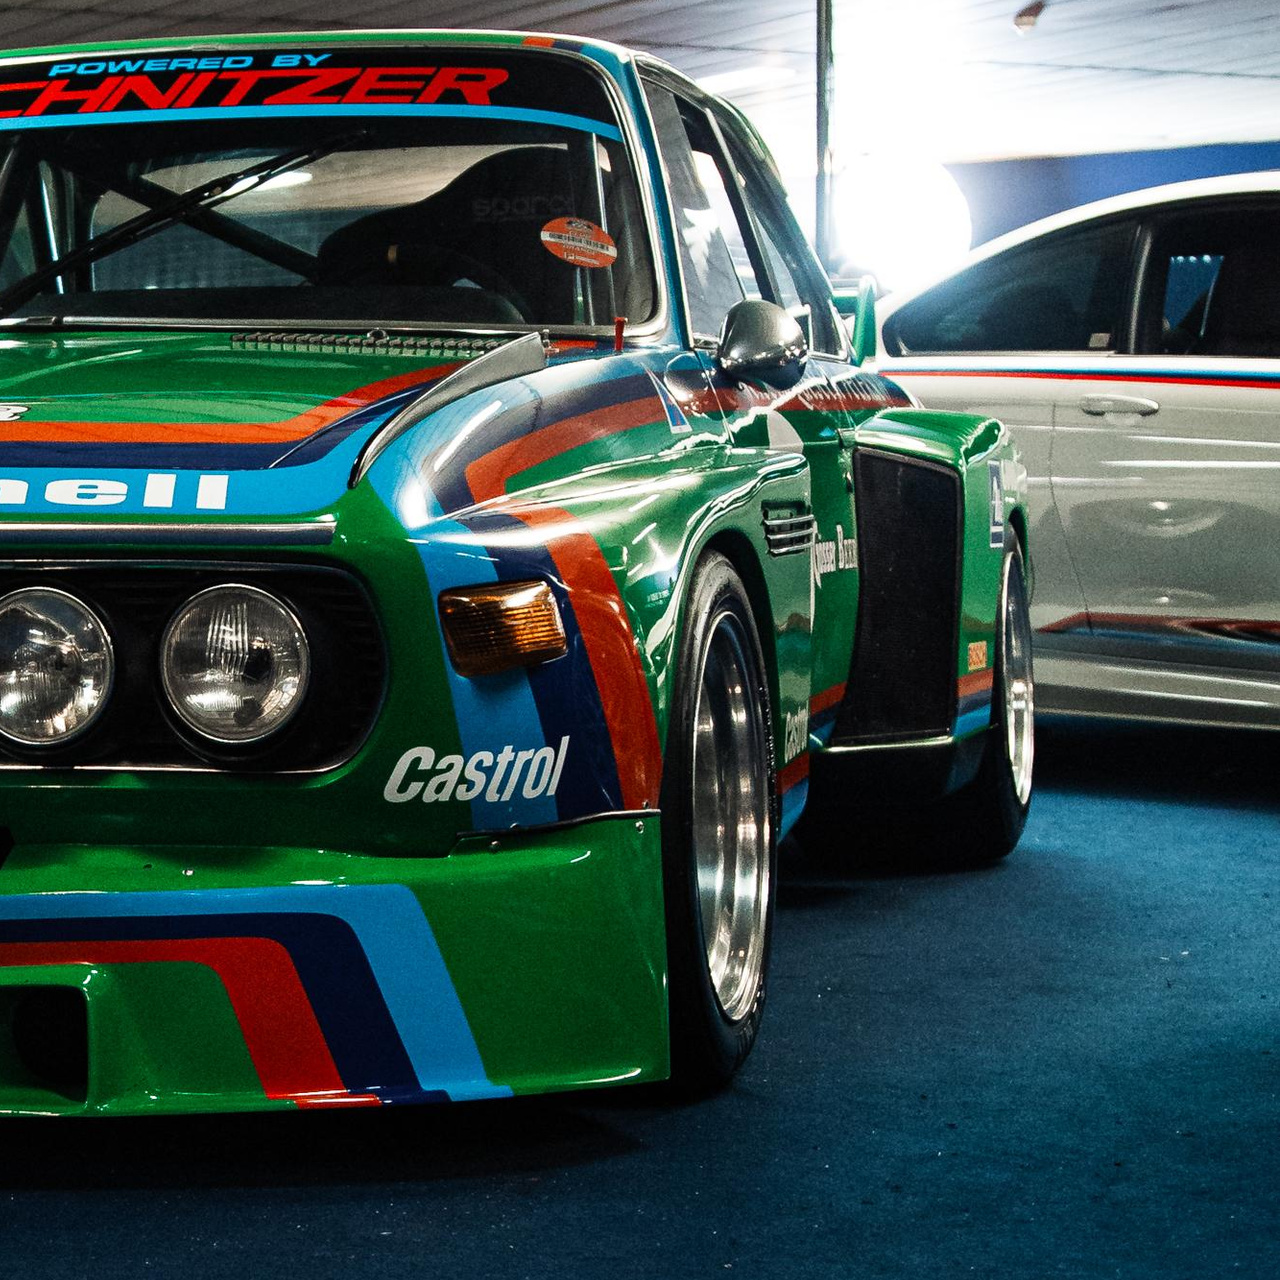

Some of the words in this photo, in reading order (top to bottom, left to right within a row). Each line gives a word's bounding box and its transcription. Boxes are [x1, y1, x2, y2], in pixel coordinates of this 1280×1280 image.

[48, 55, 253, 76] POWERED
[270, 53, 332, 68] BY
[383, 734, 570, 803] Castrol
